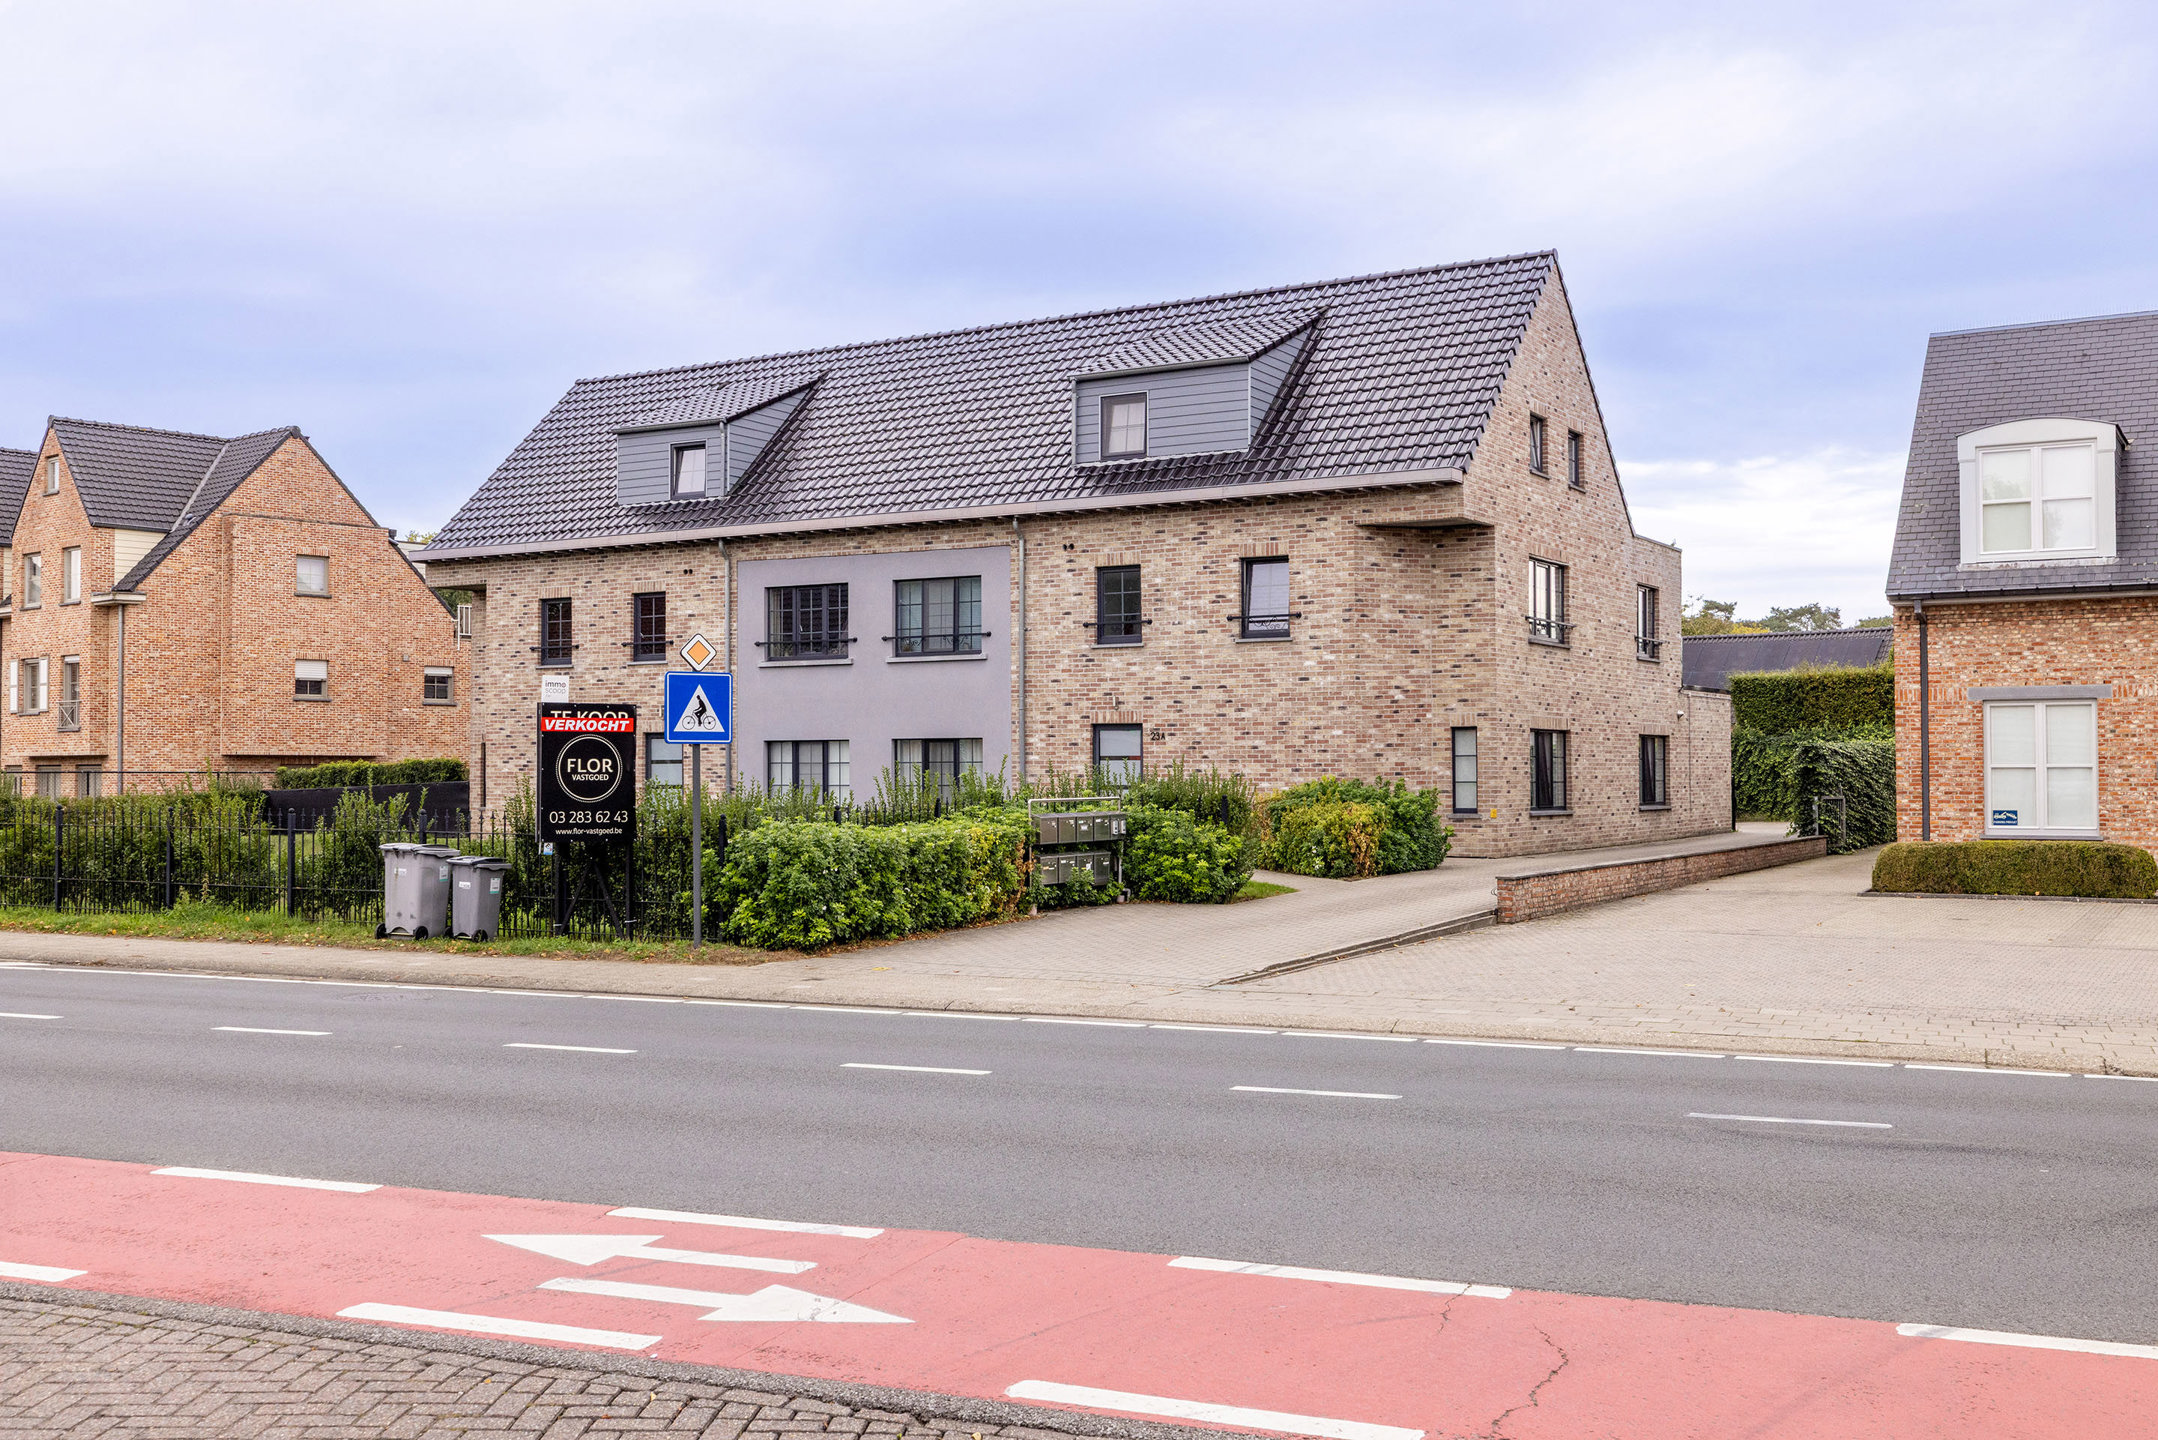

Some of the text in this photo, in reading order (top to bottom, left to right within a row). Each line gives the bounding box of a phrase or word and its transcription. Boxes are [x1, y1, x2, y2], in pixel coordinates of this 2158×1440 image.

[545, 680, 566, 688] immo
[545, 719, 630, 731] VERKOCHT
[567, 758, 614, 773] FLOR
[549, 810, 629, 824] 03 283 62 43
[555, 827, 623, 836] www.flor-vastgoed.be
